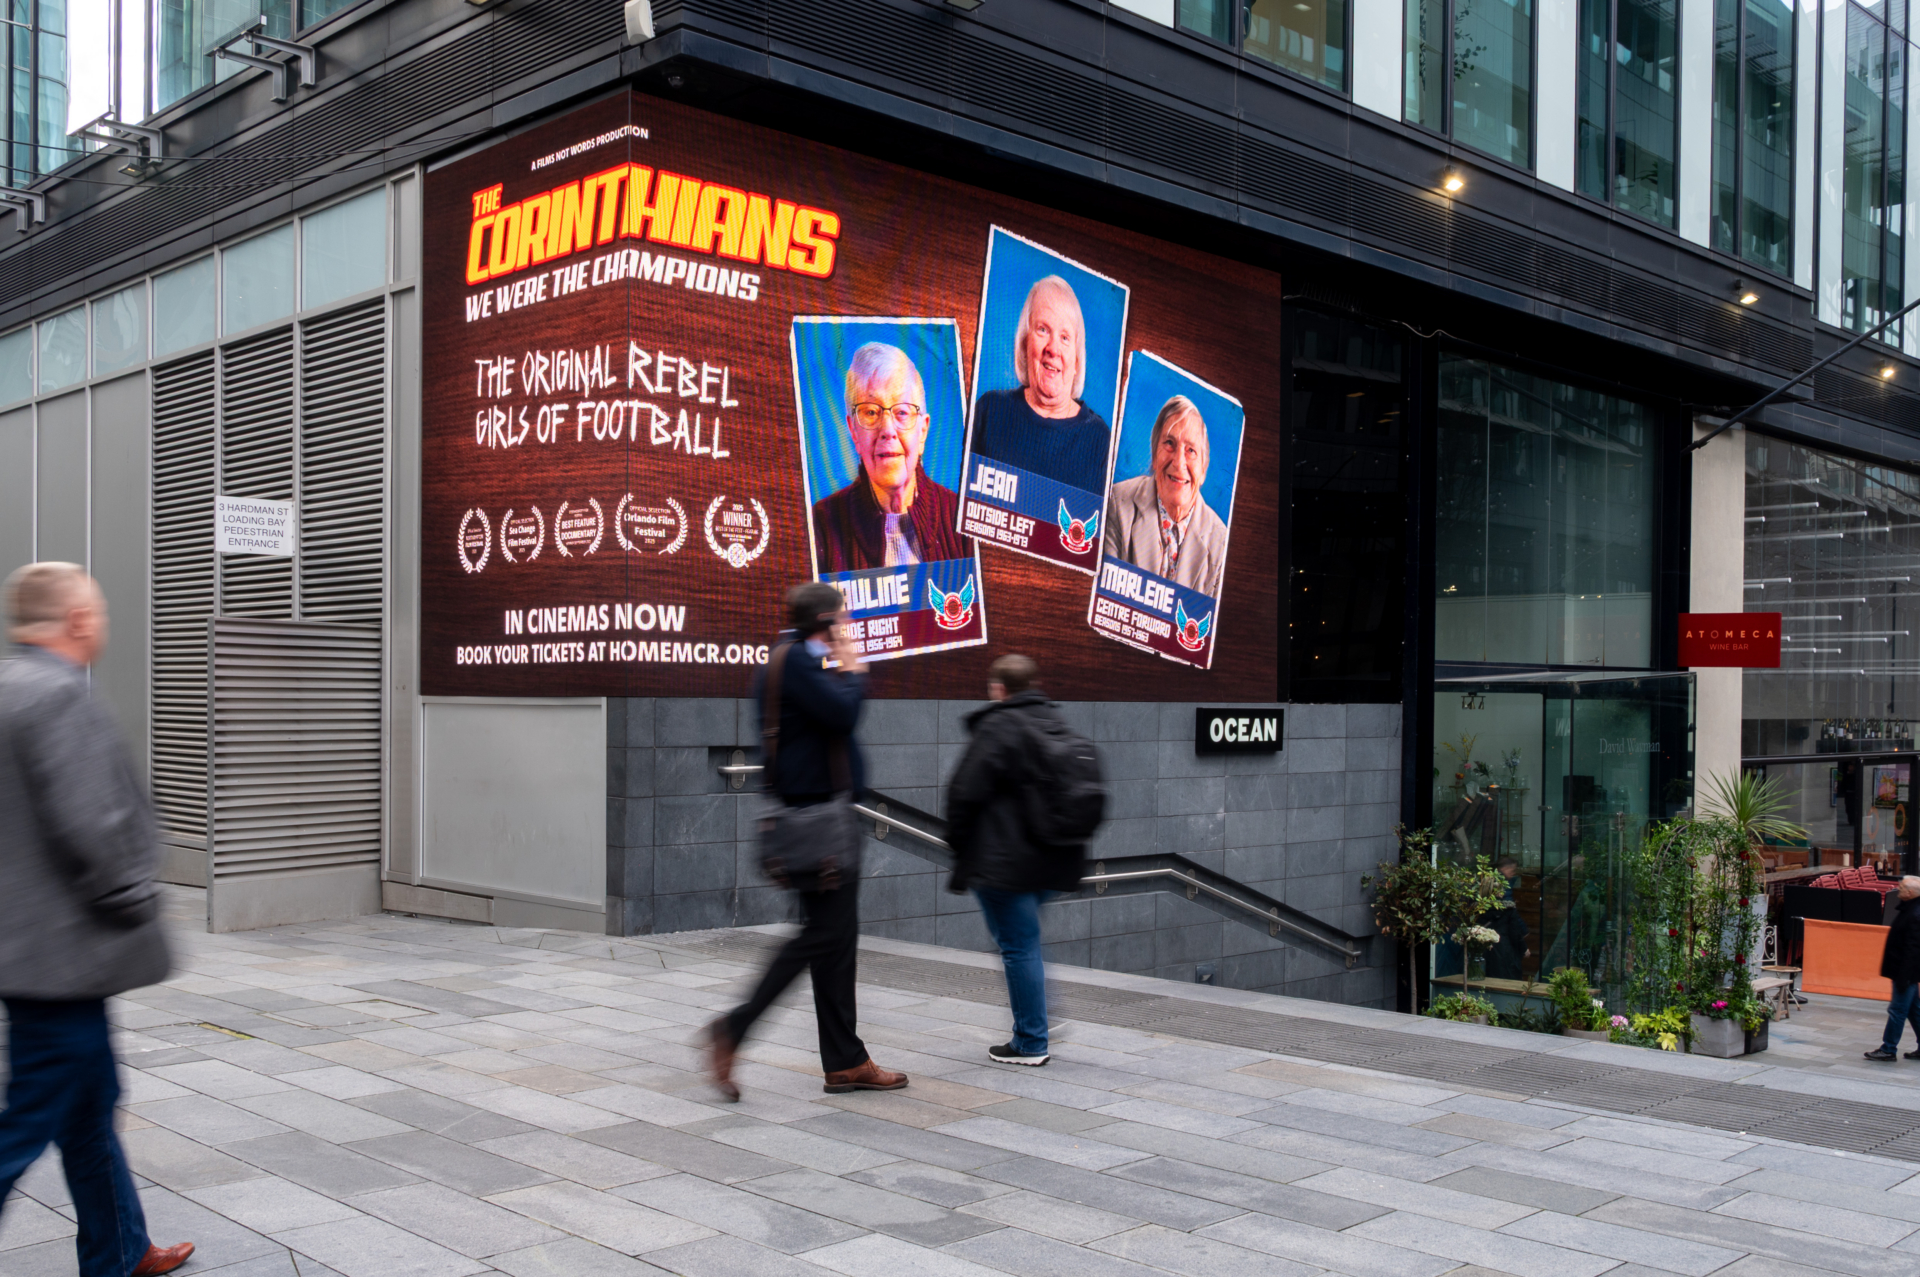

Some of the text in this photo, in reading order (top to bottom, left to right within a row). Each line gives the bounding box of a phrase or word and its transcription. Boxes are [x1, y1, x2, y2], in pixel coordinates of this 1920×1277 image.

[531, 125, 648, 171] A FILMS NOT WORDS PRODUCTION
[473, 184, 502, 217] THE
[466, 162, 840, 286] CORINTHIANS
[466, 248, 760, 323] WE WERE THE CHAMPIONS
[475, 340, 738, 408] THE ORIGINAL REBEL
[476, 400, 730, 459] GIRLS OF FOOTBALL
[970, 464, 1018, 503] JEAN
[228, 504, 274, 515] HARDMAN
[624, 513, 675, 525] Orlando Film
[723, 511, 752, 527] WINNER
[966, 501, 1035, 536] OUTSIDE LEFT
[223, 515, 285, 526] LOADING BAY
[518, 525, 535, 534] Change
[562, 517, 596, 529] BEST FEATURE
[965, 519, 996, 538] SEASONS
[224, 526, 284, 537] PEDESTRIAN
[561, 529, 597, 540] DOCUMENTARY
[634, 527, 666, 538] Festival
[228, 538, 279, 548] ENTRANCE
[508, 536, 536, 547] Film Festival
[830, 573, 910, 612] AULINE
[1100, 562, 1175, 614] MARLENE
[505, 603, 686, 635] IN CINEMAS NOW
[1094, 614, 1121, 632] SEASONS
[1096, 597, 1131, 623] CENTRE
[1131, 610, 1171, 638] FORWARD
[840, 616, 899, 640] SIDE RIGHT
[1686, 630, 1774, 639] ATOMECA
[457, 640, 769, 665] BOOK YOUR TICKETS AT HOMEMCR.ORG
[867, 635, 903, 652] 1956-1964
[1210, 718, 1277, 742] OCEAN
[1600, 738, 1660, 757] David Wayman
